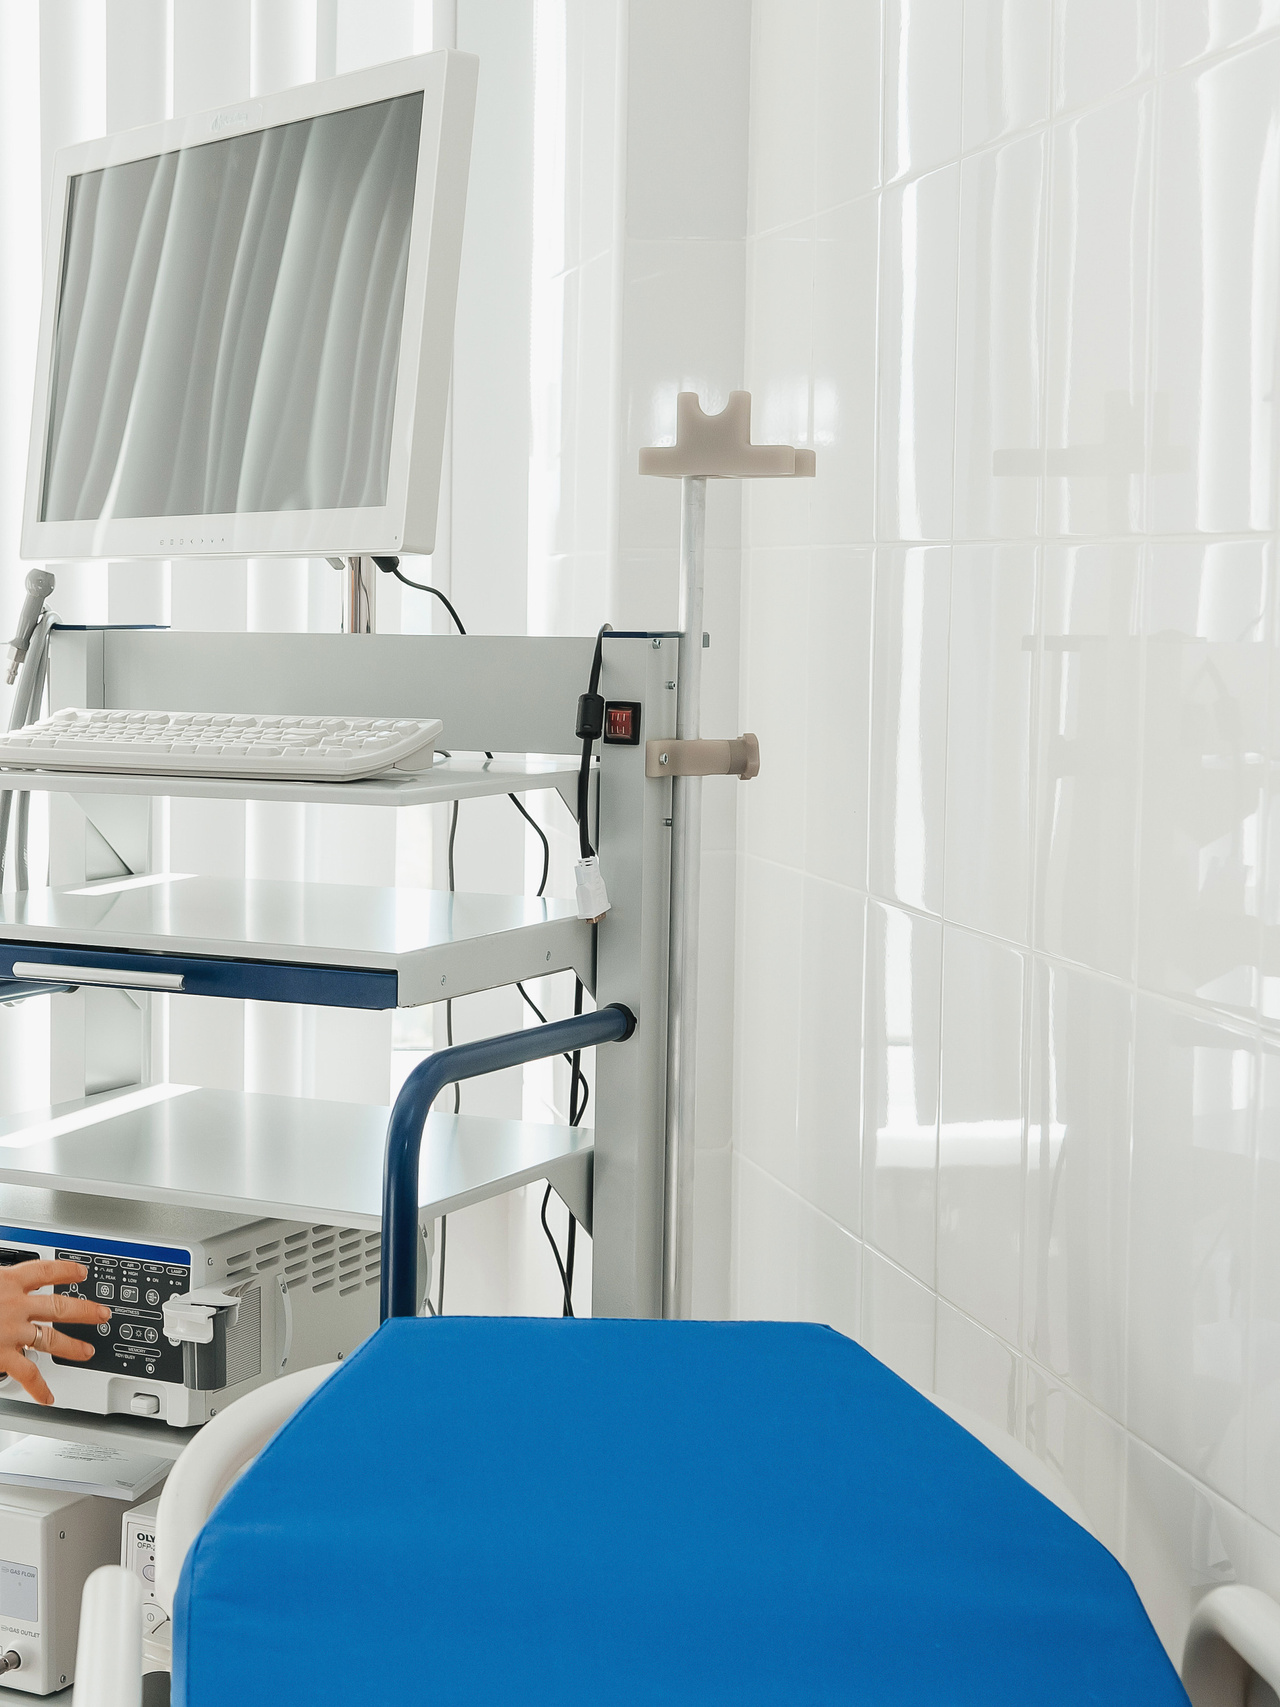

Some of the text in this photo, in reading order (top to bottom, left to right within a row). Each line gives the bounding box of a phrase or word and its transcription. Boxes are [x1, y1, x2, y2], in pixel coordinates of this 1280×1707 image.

[115, 1308, 140, 1316] BRIGHTNESS
[10, 1568, 36, 1578] GAS FLOW
[8, 1626, 40, 1638] GAS OUTLET
